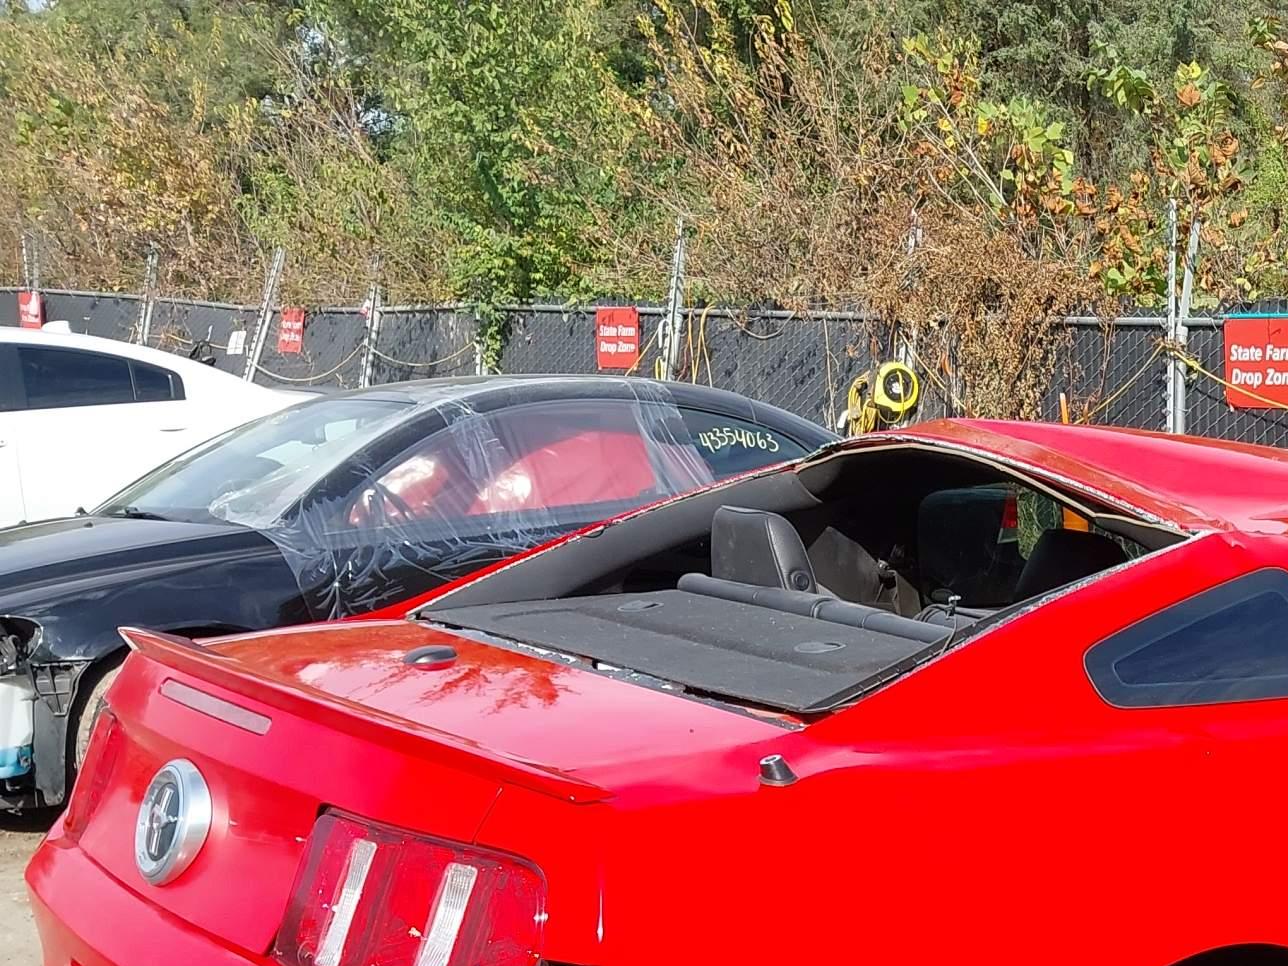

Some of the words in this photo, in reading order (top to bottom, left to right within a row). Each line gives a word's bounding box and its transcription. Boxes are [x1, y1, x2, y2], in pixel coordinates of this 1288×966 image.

[1230, 344, 1263, 360] State
[1231, 368, 1263, 388] Drop
[698, 427, 780, 454] 43354063
